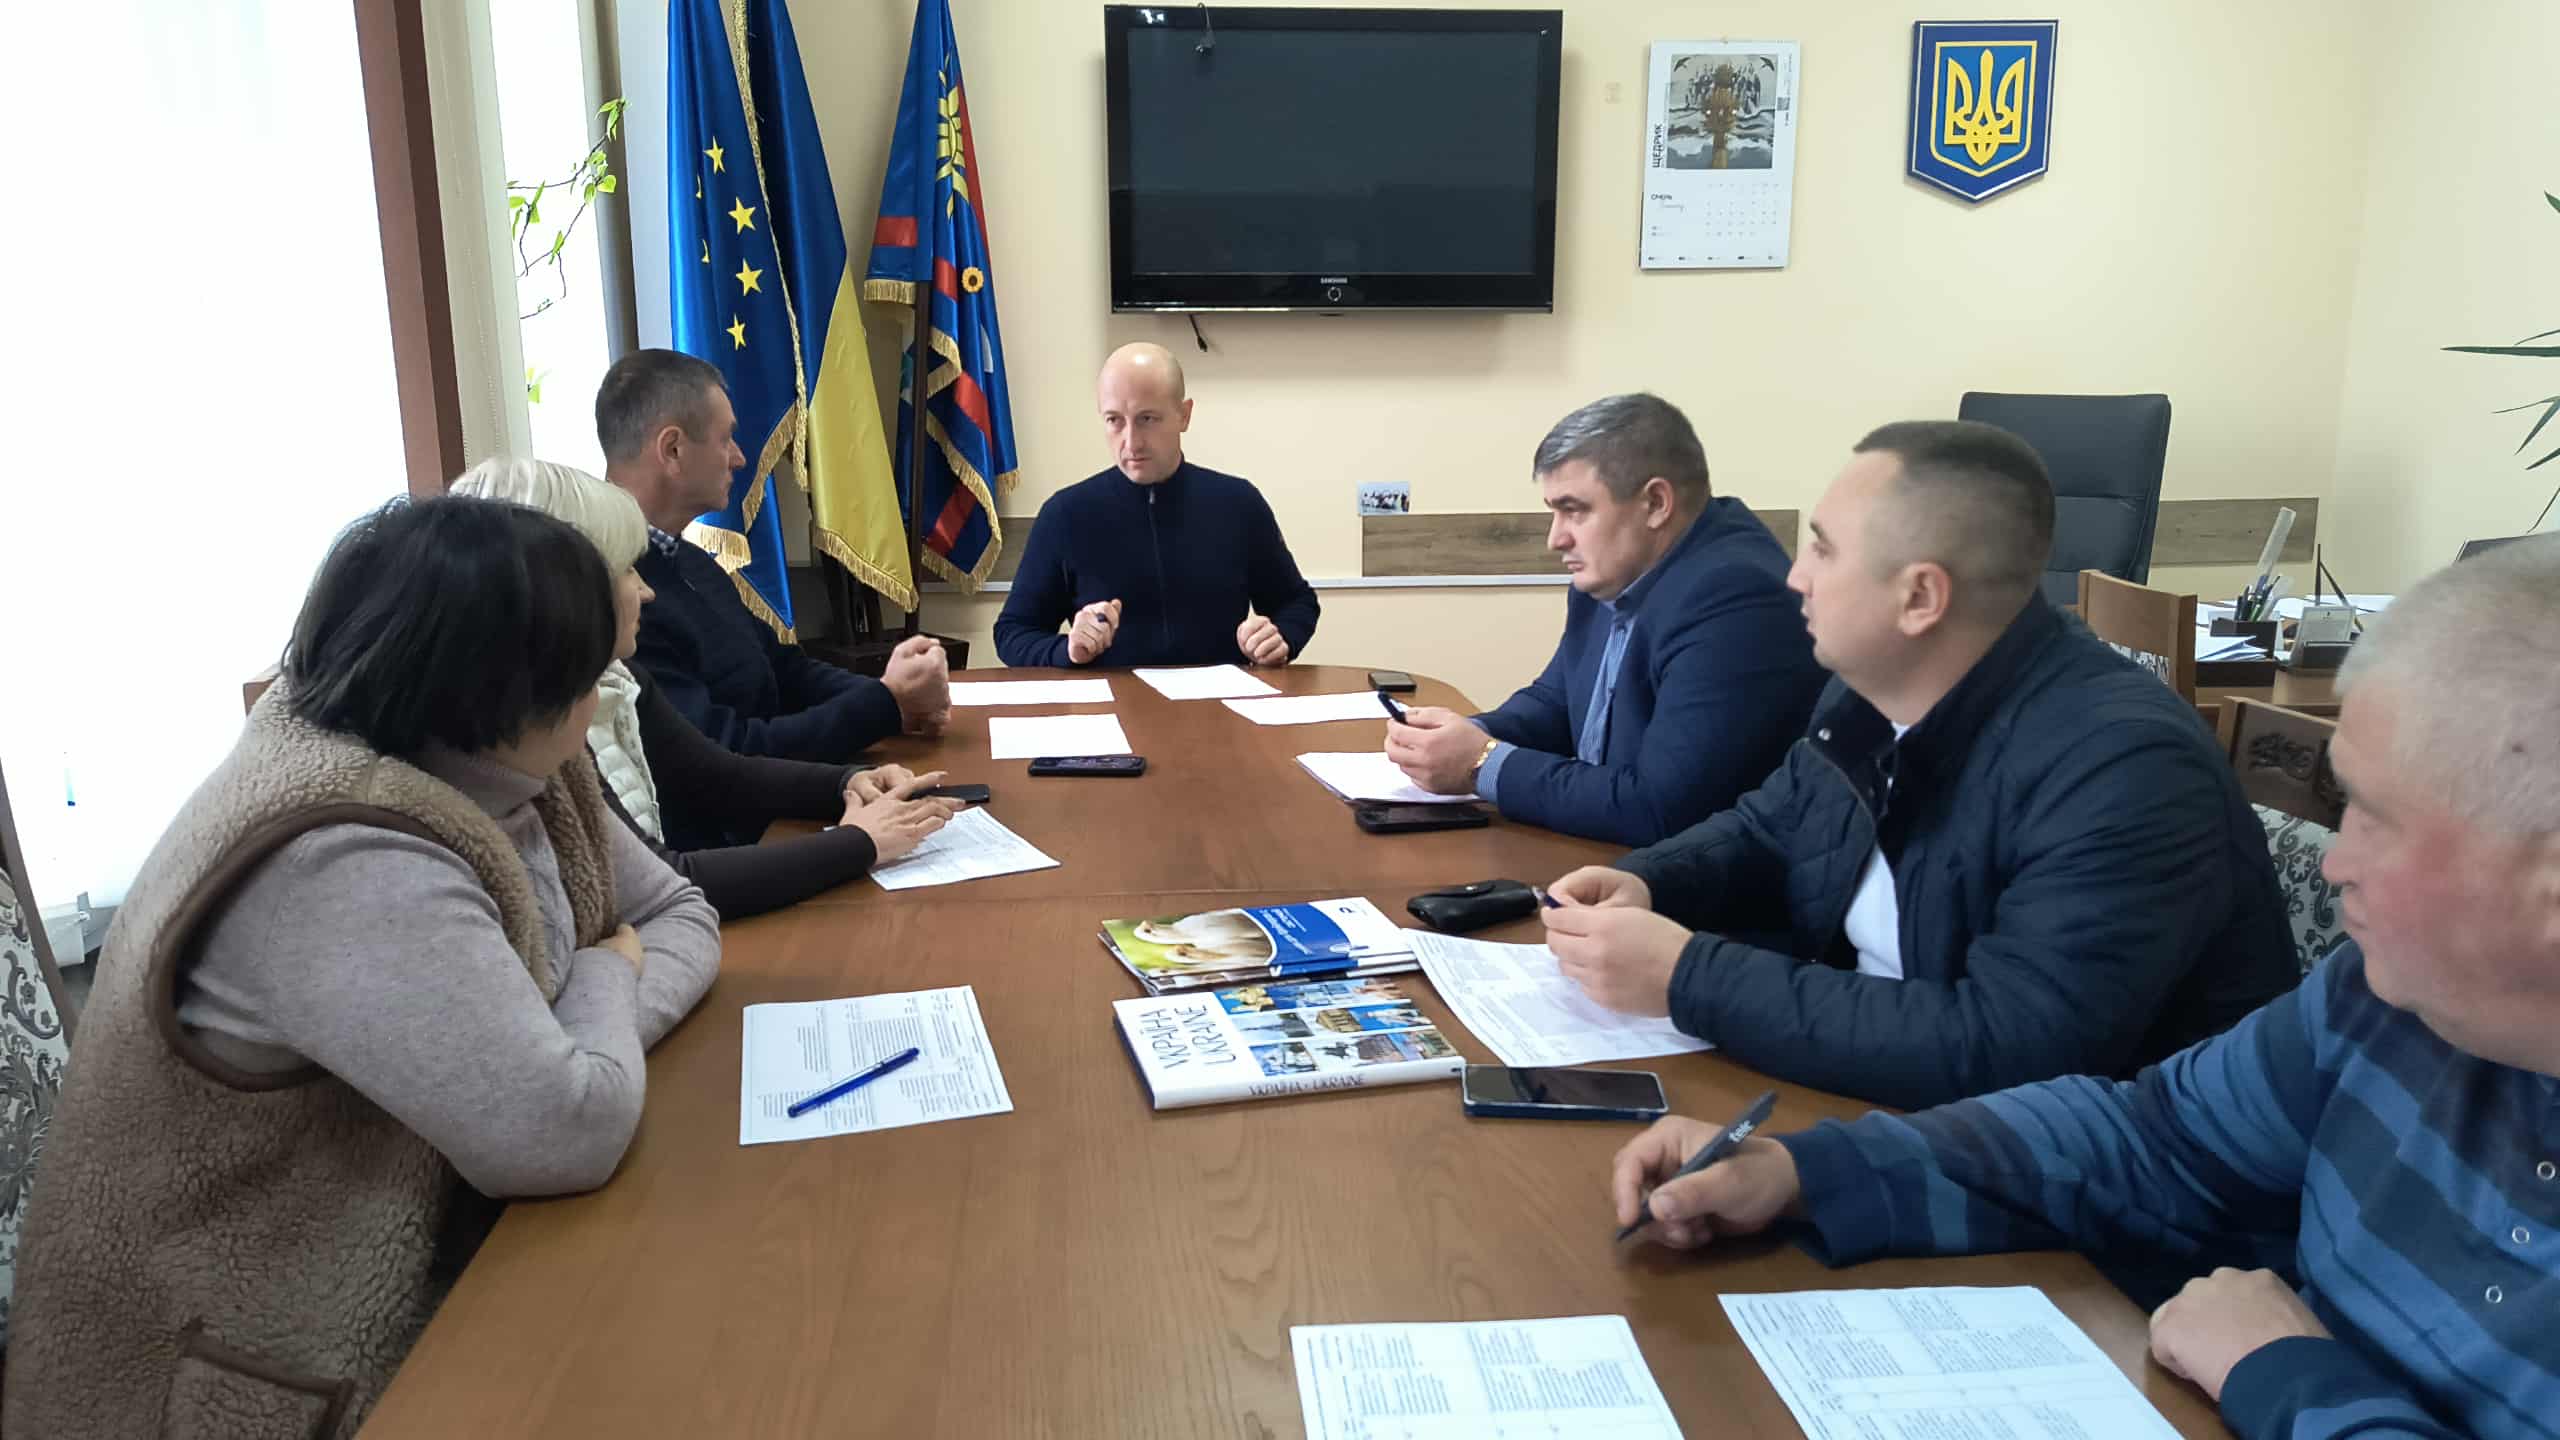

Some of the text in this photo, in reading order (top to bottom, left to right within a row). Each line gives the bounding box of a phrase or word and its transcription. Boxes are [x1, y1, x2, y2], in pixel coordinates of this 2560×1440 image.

[1652, 123, 1664, 168] ЩЕДРИК
[1139, 1008, 1191, 1069] УКРАЇНА
[1174, 1005, 1236, 1065] UKRAINE
